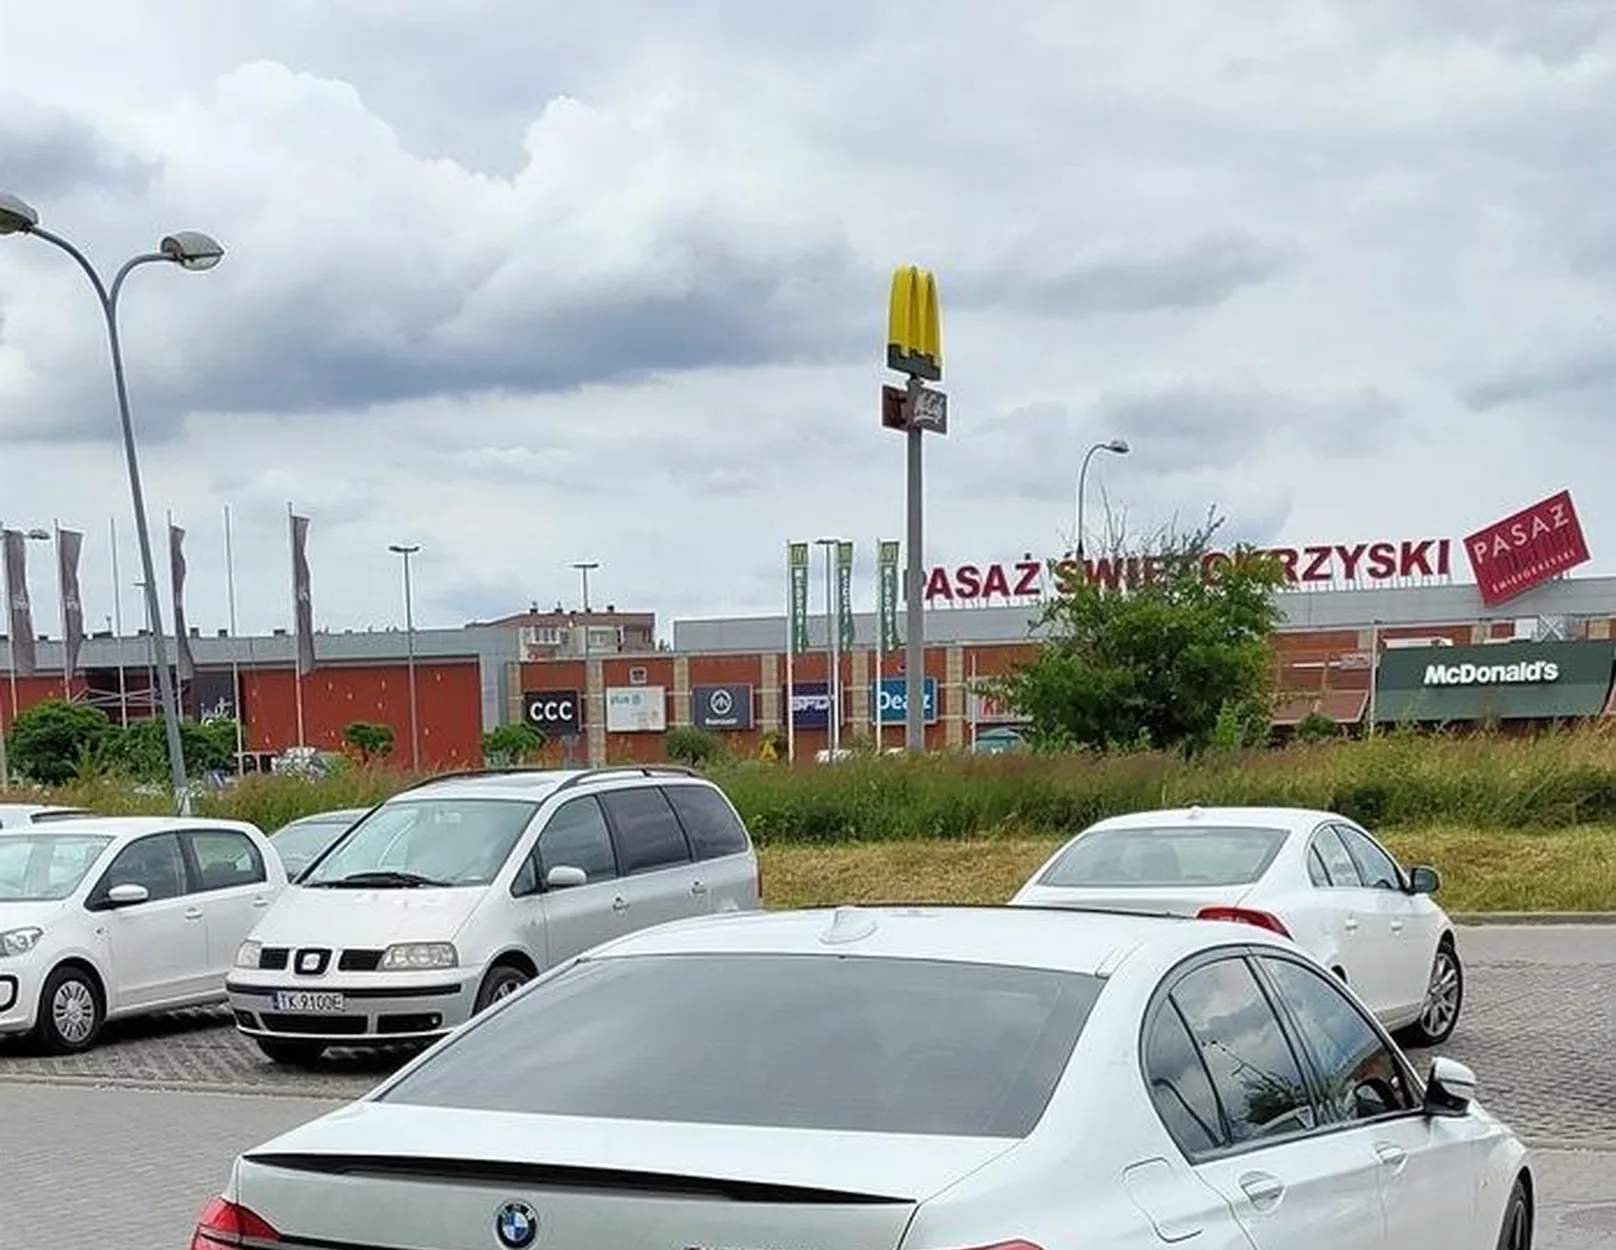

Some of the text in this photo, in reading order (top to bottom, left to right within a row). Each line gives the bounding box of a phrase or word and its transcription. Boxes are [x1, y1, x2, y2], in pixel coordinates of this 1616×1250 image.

[904, 553, 1041, 600] ASAŻ
[1423, 661, 1559, 685] McDonald's
[529, 701, 573, 721] CCC
